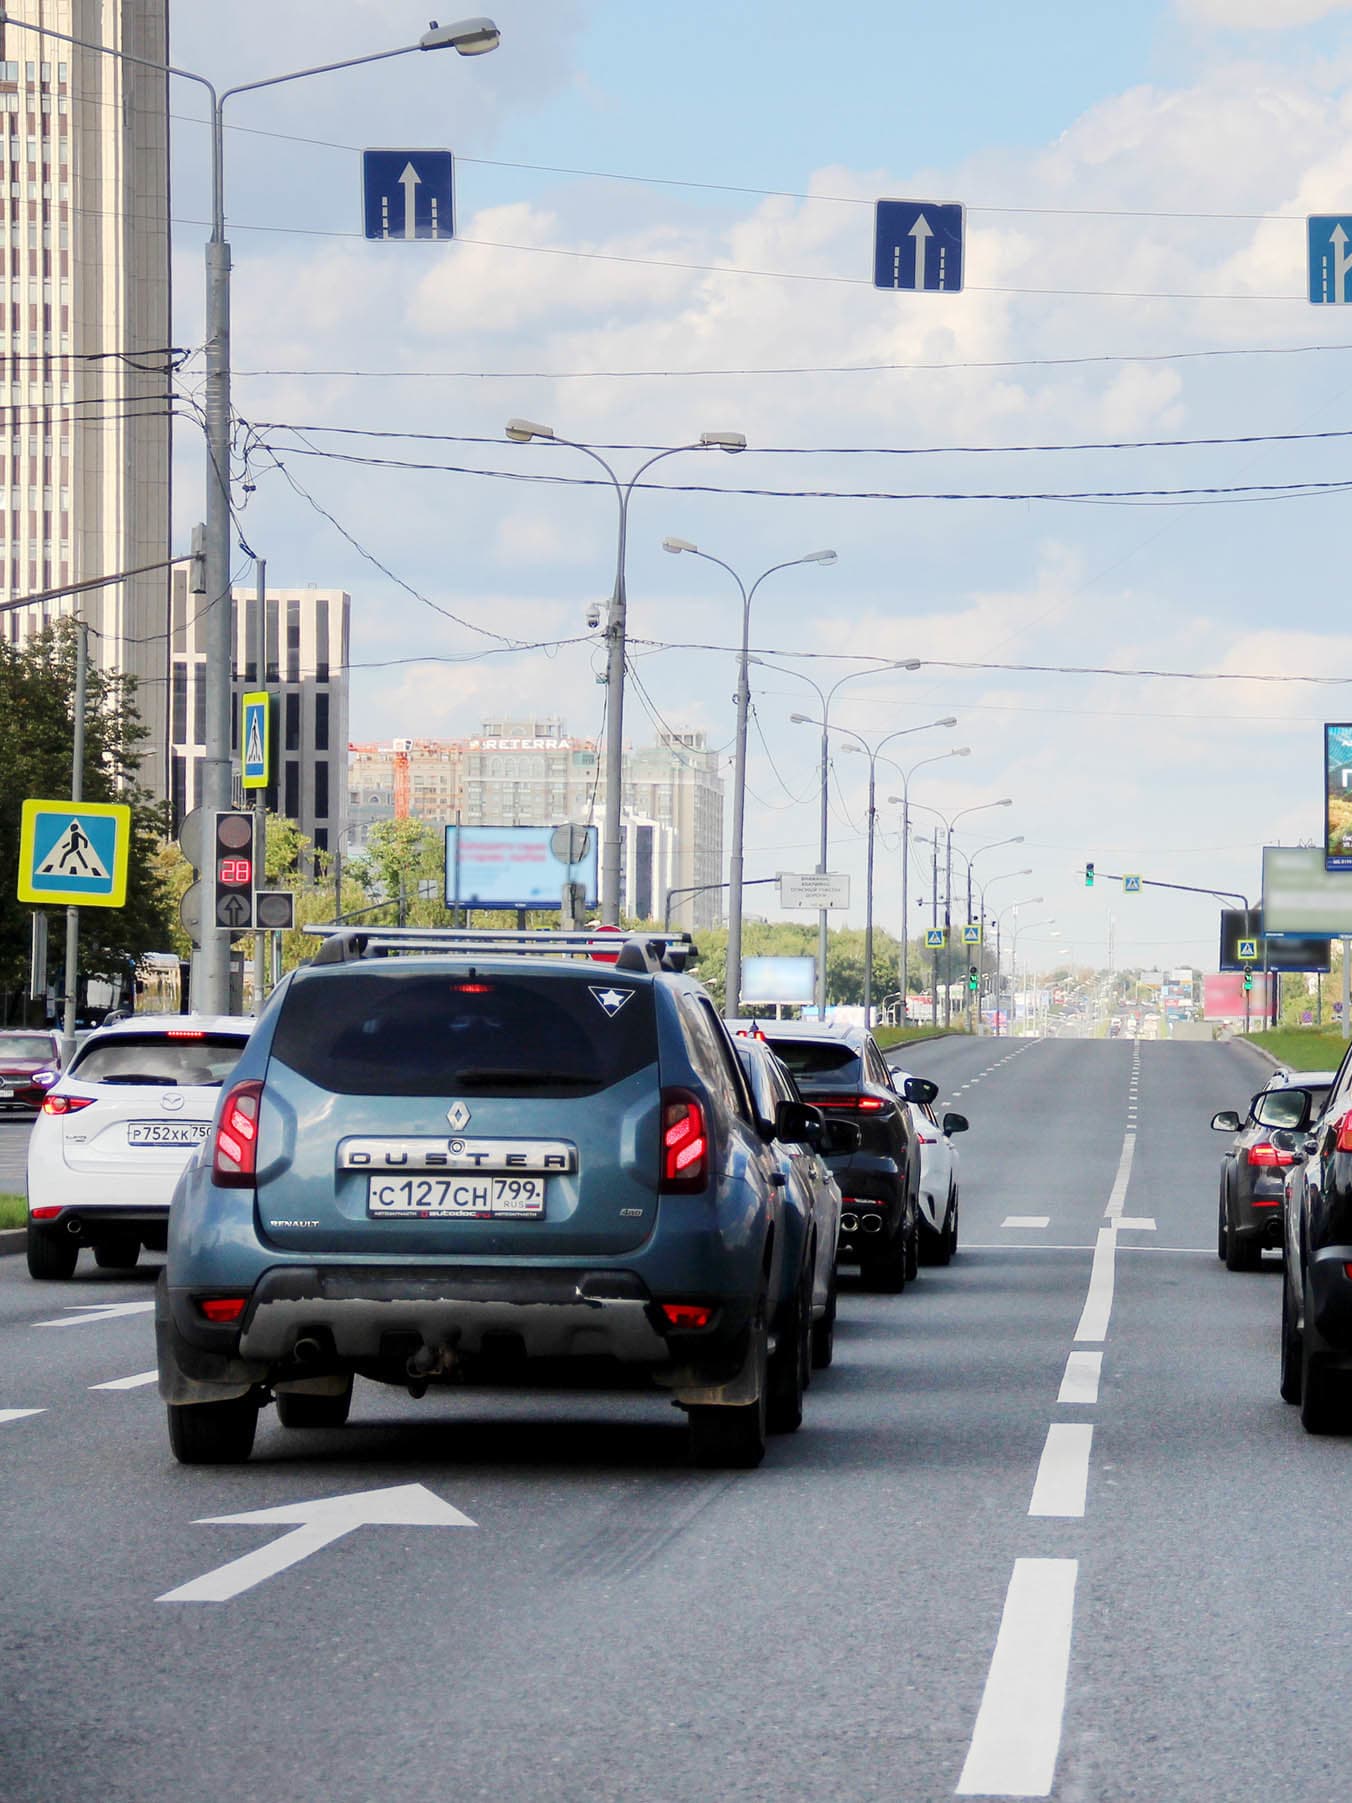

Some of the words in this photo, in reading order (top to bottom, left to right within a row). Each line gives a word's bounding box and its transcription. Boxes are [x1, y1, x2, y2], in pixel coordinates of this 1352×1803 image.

[221, 861, 249, 881] 28
[133, 1127, 189, 1141] Р752ХК
[348, 1152, 566, 1168] DUSTER
[379, 1181, 488, 1206] С127СН
[495, 1180, 536, 1200] 799
[270, 1220, 320, 1228] RENAULT
